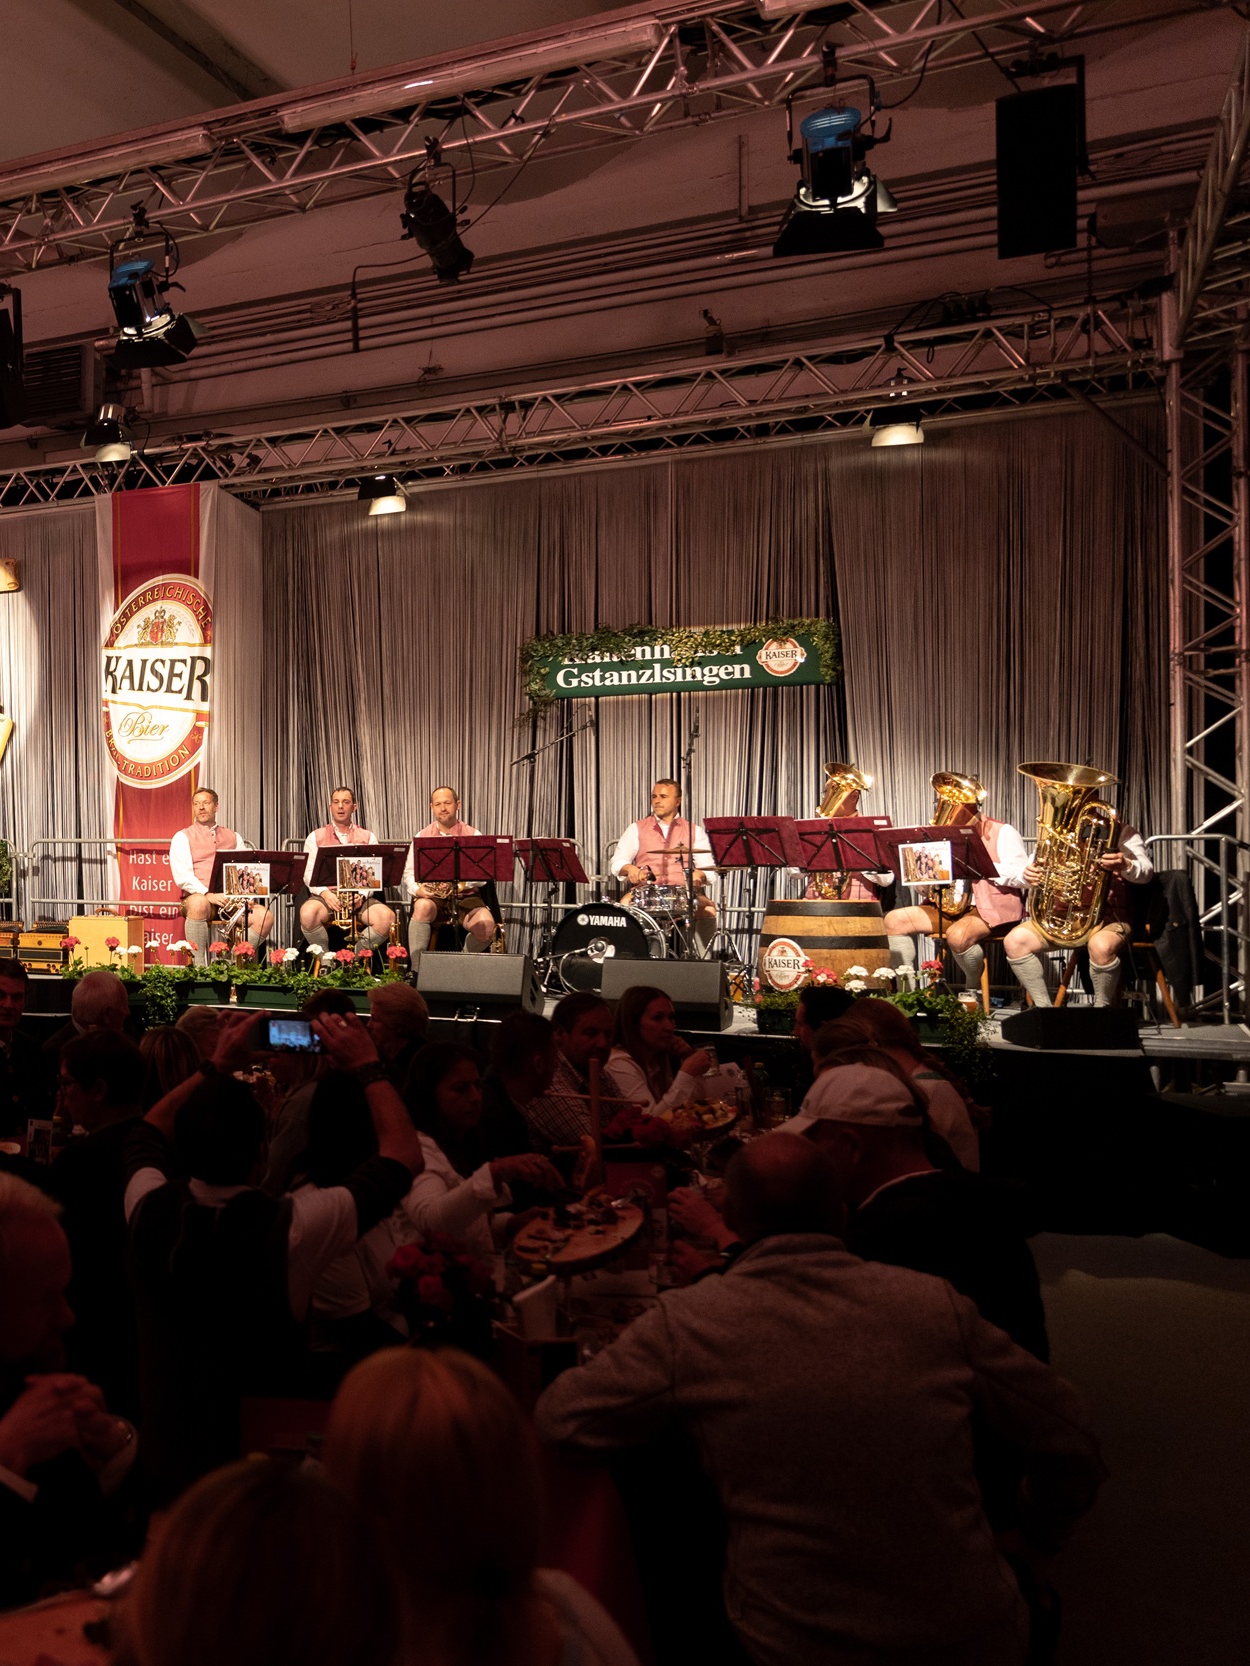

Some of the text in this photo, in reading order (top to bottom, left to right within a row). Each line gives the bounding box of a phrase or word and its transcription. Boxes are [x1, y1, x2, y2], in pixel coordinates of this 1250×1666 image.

[113, 585, 212, 634] ÖSTERREICHISCHE
[765, 649, 798, 660] KAISER
[104, 655, 211, 703] KAISER
[556, 663, 753, 689] Gstanzlsingen
[118, 711, 169, 739] Bier
[129, 850, 157, 865] Hast
[132, 875, 173, 892] Kaiser
[589, 914, 627, 928] YAMAHA
[143, 928, 174, 944] aiser
[767, 957, 801, 970] KAISER
